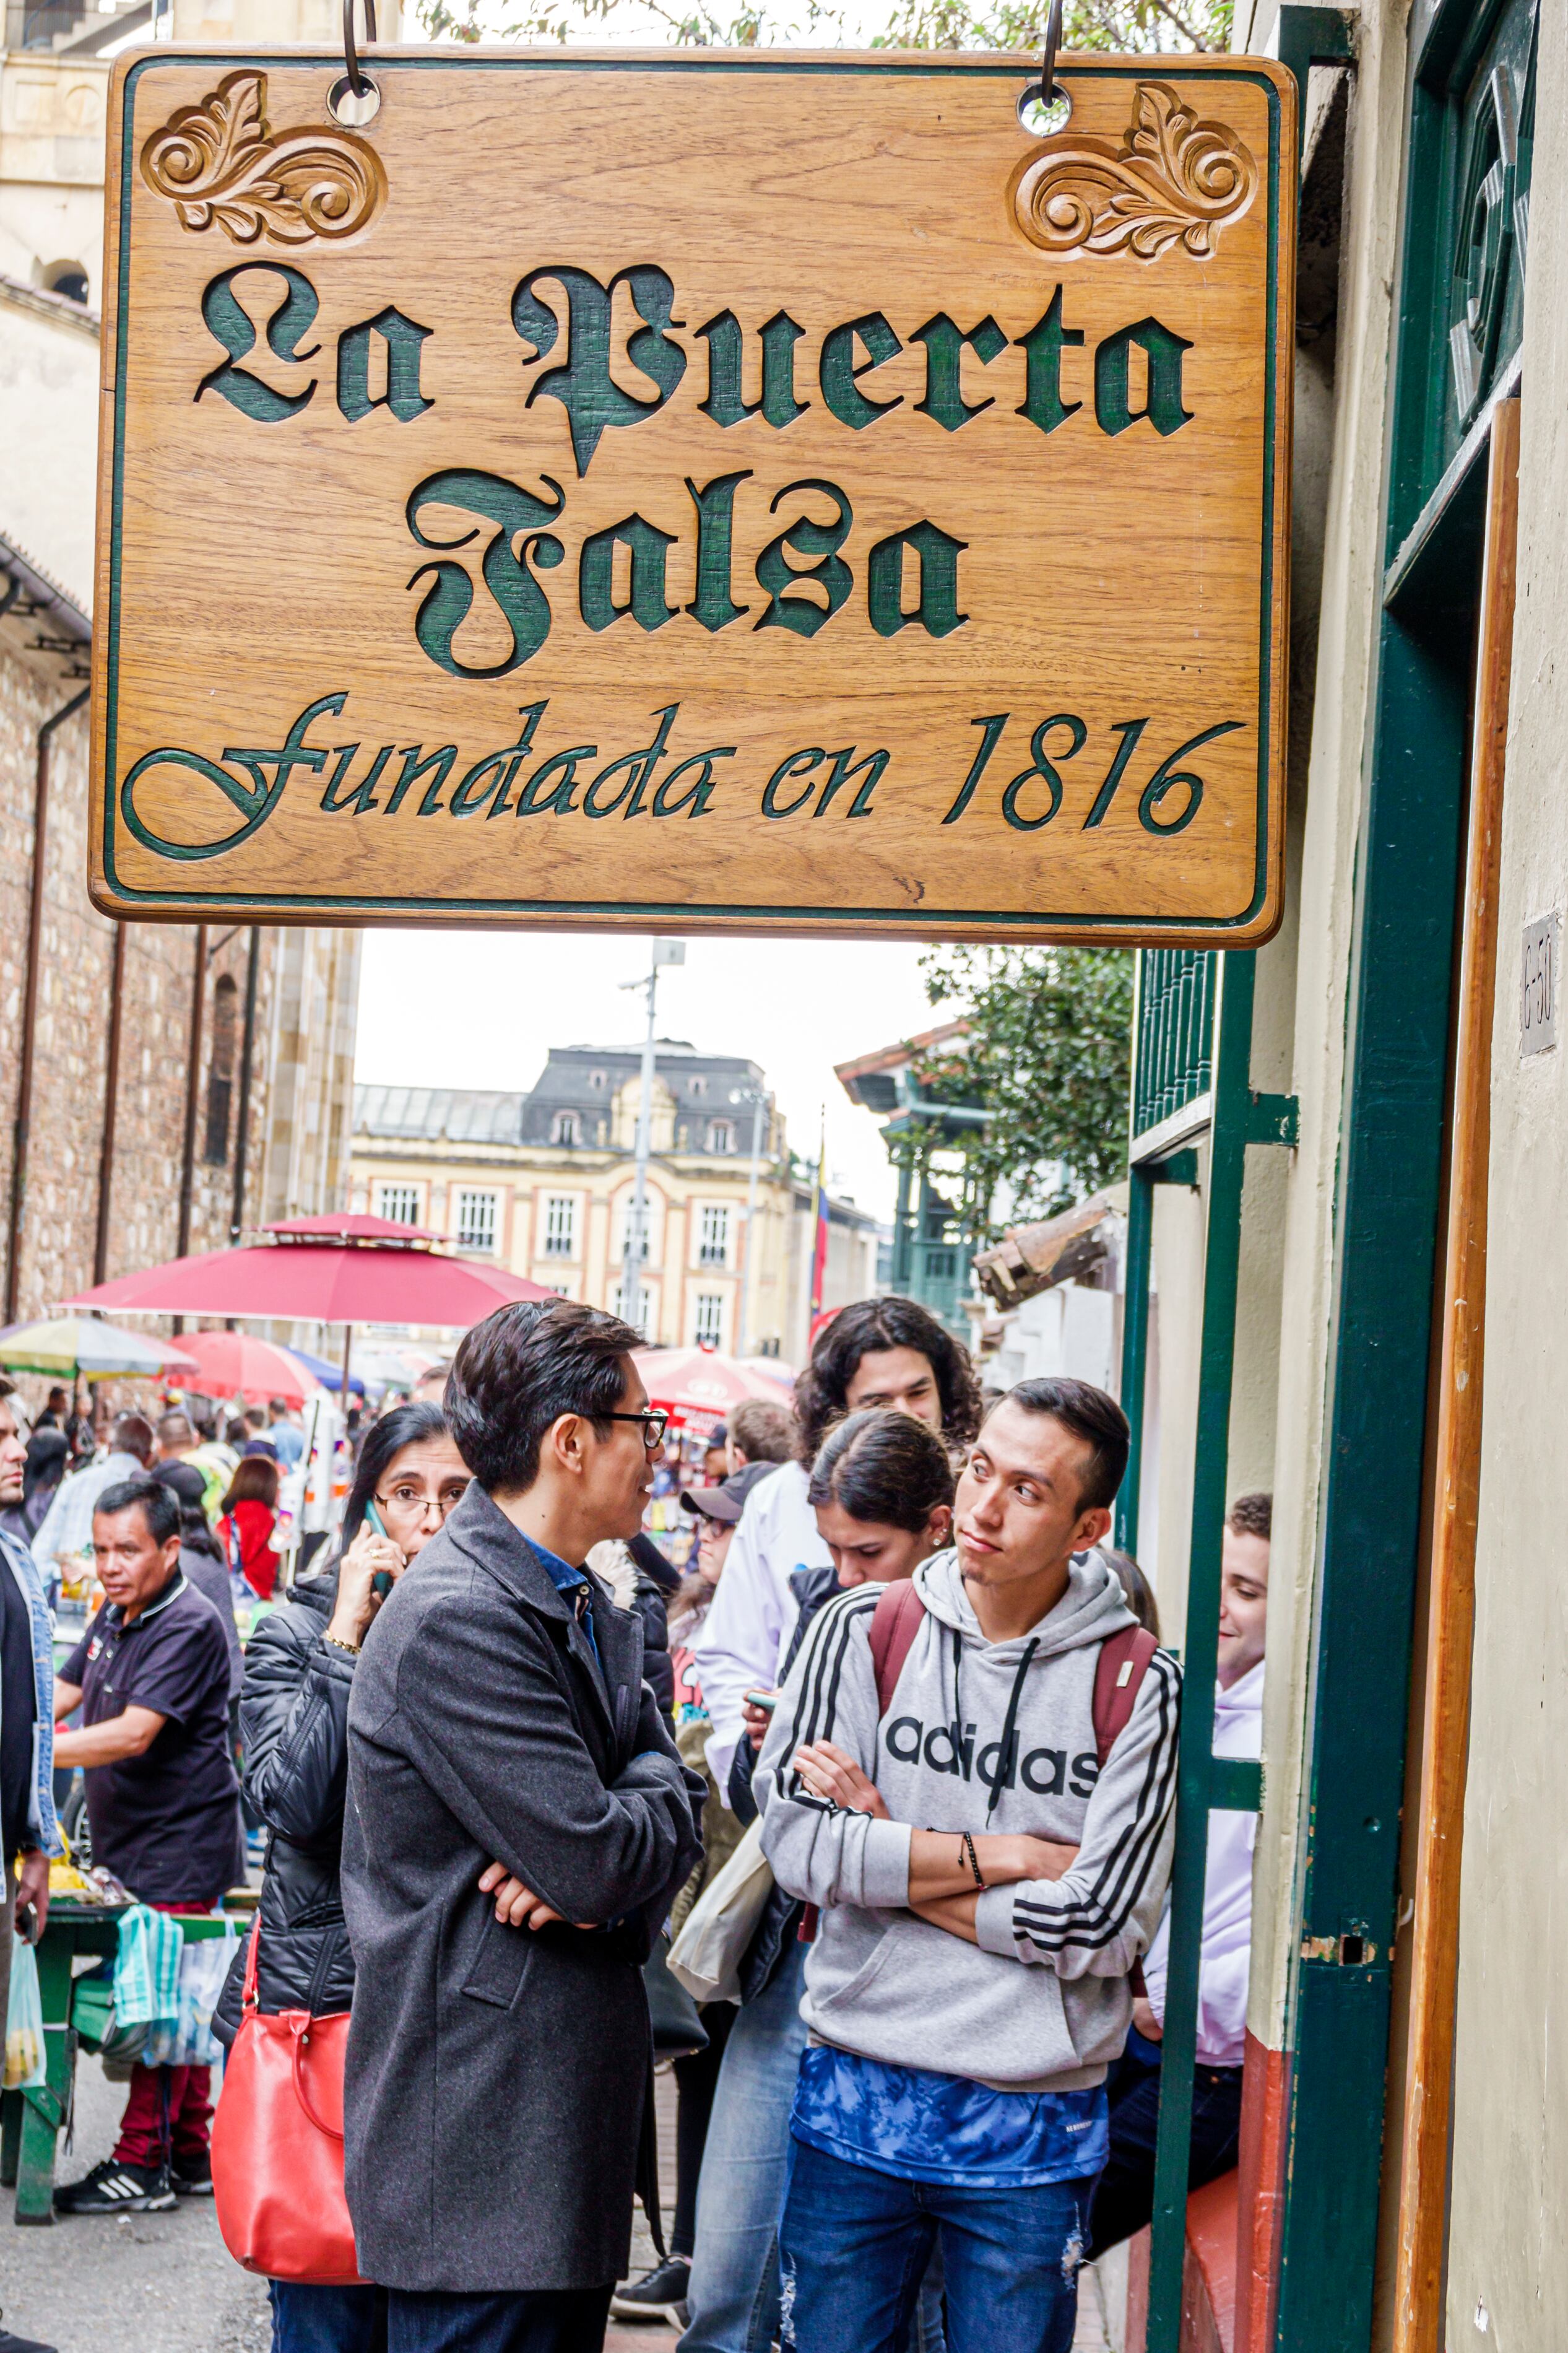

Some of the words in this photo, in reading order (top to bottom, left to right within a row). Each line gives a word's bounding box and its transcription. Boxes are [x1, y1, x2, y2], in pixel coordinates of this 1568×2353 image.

[193, 261, 436, 424] La
[512, 264, 1195, 479] Puerta
[406, 468, 969, 679] Falsa
[762, 746, 891, 819] en
[943, 712, 1248, 836] 1816
[1524, 934, 1551, 1029] 6-50
[886, 1716, 1099, 1799] adidas
